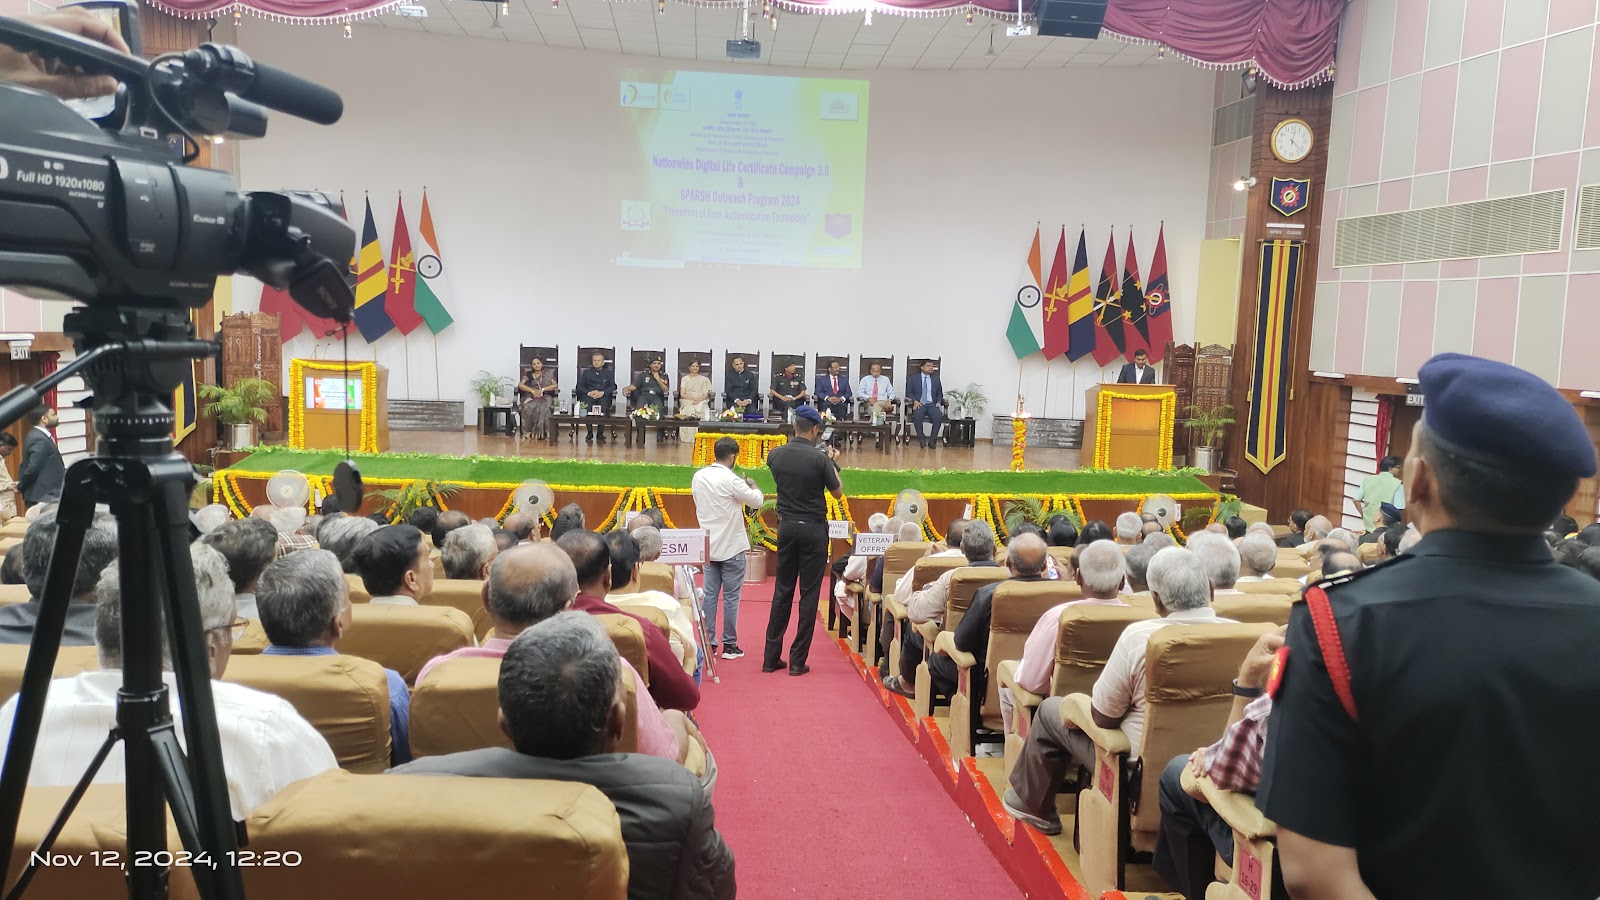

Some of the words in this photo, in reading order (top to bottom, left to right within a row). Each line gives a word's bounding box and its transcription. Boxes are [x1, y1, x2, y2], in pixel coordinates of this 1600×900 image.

[652, 155, 694, 170] Nationwide
[696, 158, 720, 174] Digital
[722, 160, 736, 173] Life
[738, 161, 777, 175] Certificate
[779, 163, 815, 179] Campaign
[817, 164, 830, 177] 3.0
[16, 169, 35, 183] Full
[37, 172, 53, 186] HD
[55, 175, 105, 192] 1920x1080
[737, 176, 744, 189] &
[680, 188, 710, 203] SPARSH
[713, 190, 746, 205] Outreach
[748, 192, 779, 208] Program
[781, 194, 801, 207] 2024
[707, 208, 722, 219] Face
[724, 209, 771, 222] Authentication
[12, 346, 30, 360] EXIT
[1407, 394, 1425, 405] EXIT
[858, 536, 891, 544] VETERAN
[661, 543, 688, 554] ESM
